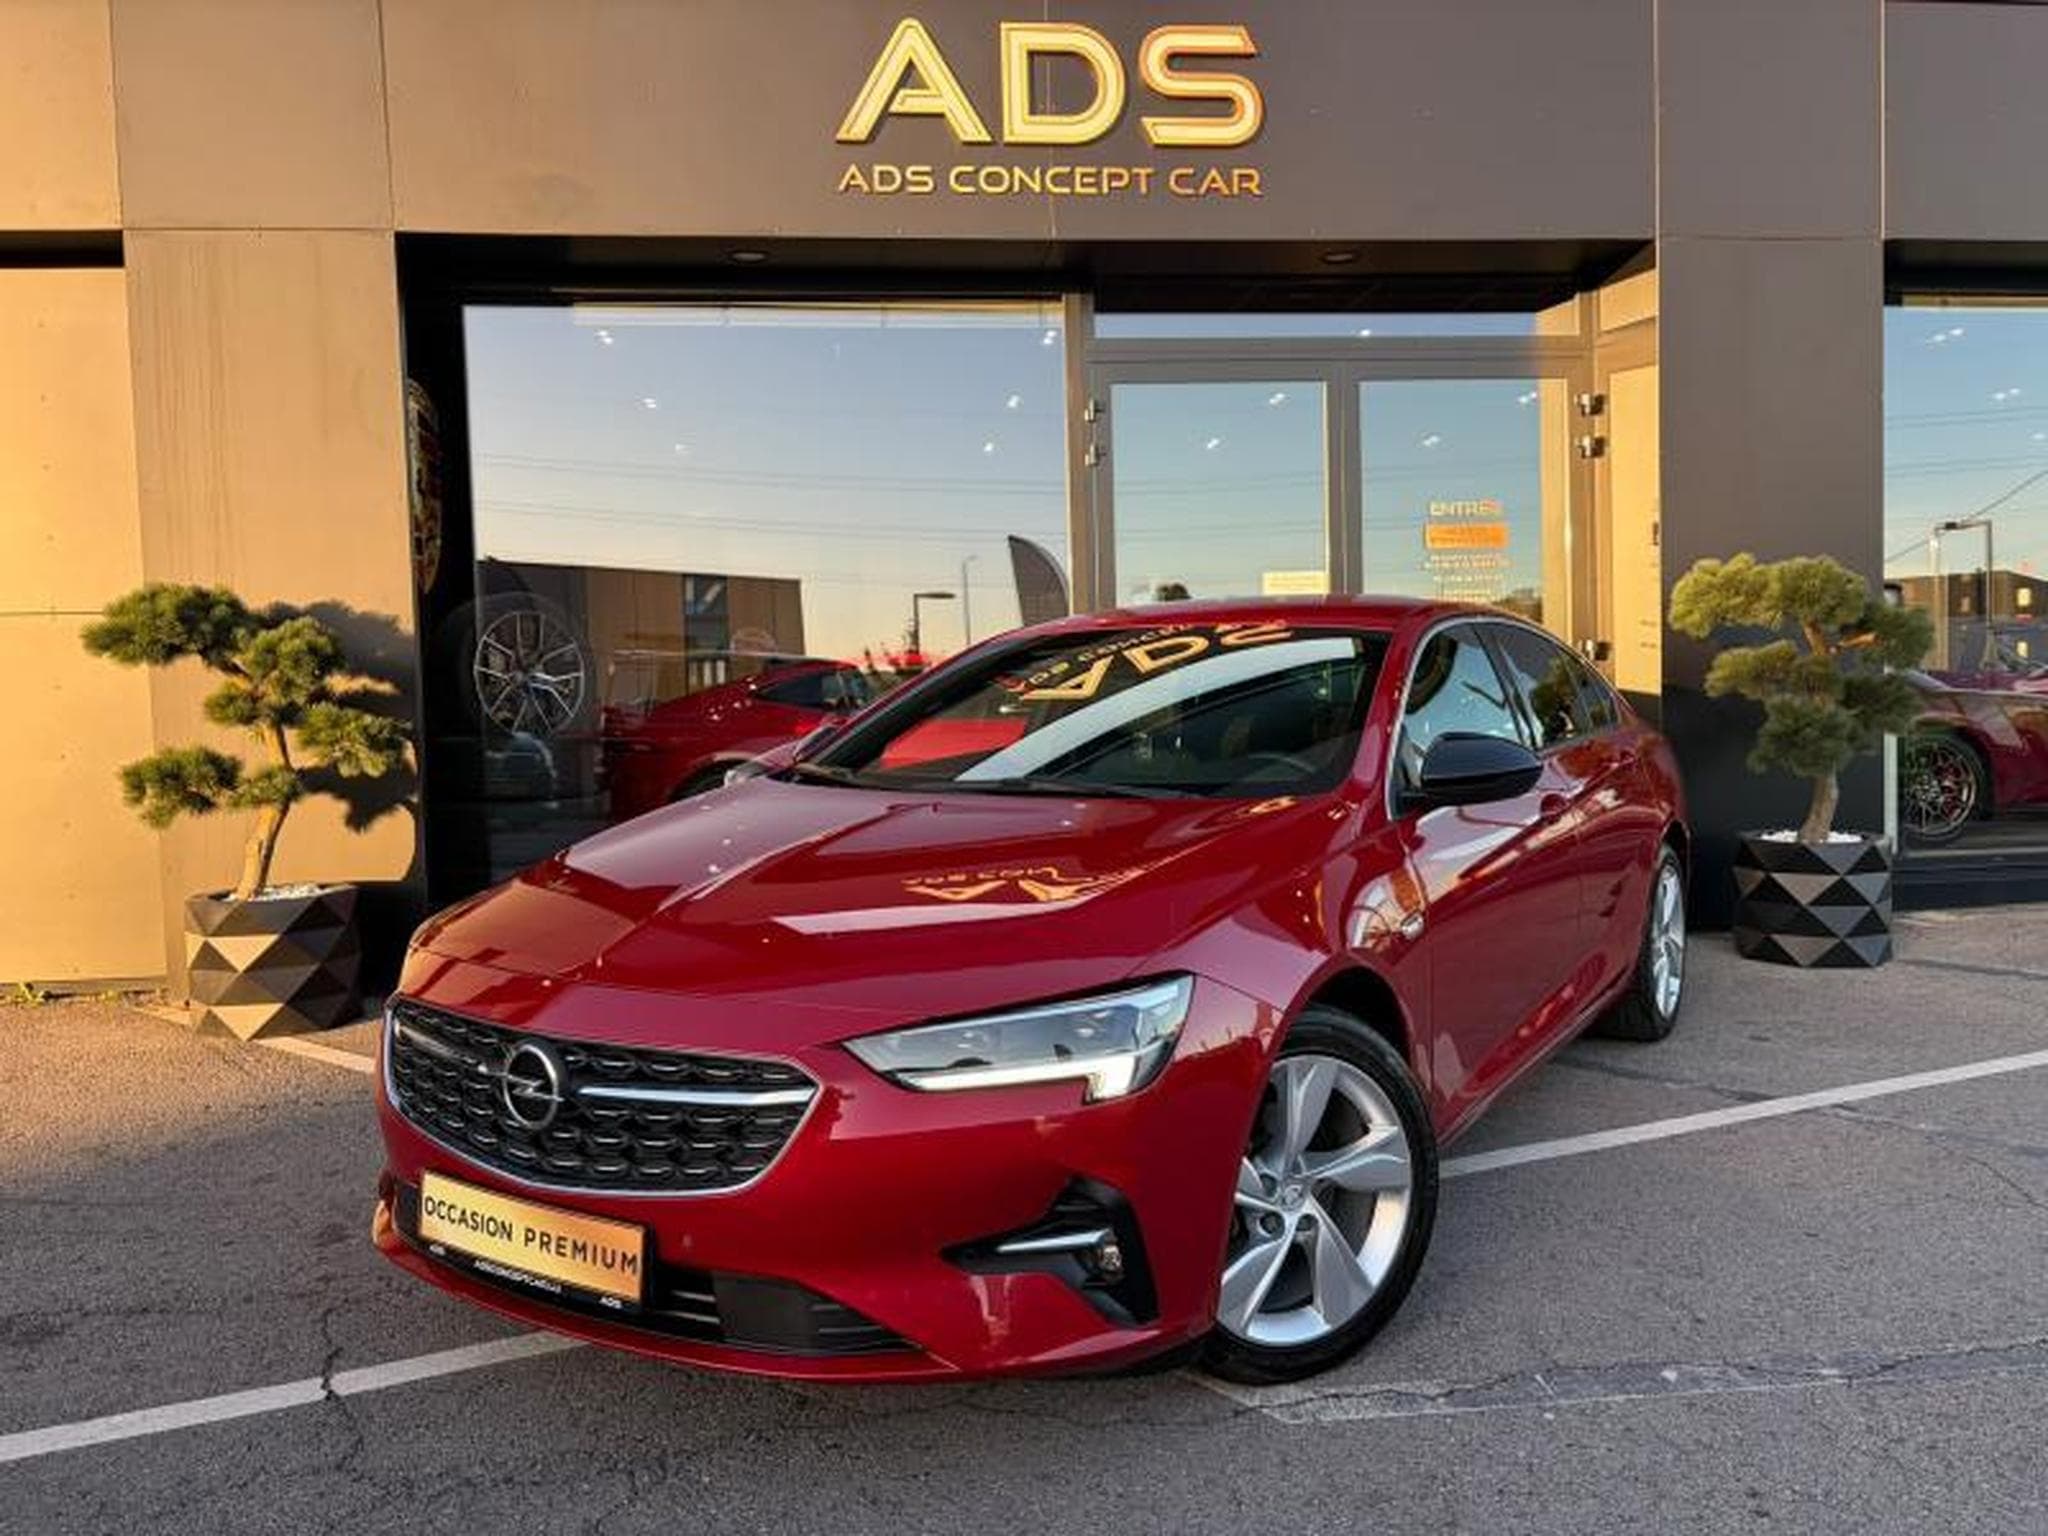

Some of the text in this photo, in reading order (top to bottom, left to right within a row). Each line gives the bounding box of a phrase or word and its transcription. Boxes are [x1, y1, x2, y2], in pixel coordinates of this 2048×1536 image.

[835, 17, 1264, 146] ADS
[838, 163, 1263, 197] ADS CONCEPT CAR
[424, 1196, 638, 1275] OCCASION PREMIUM
